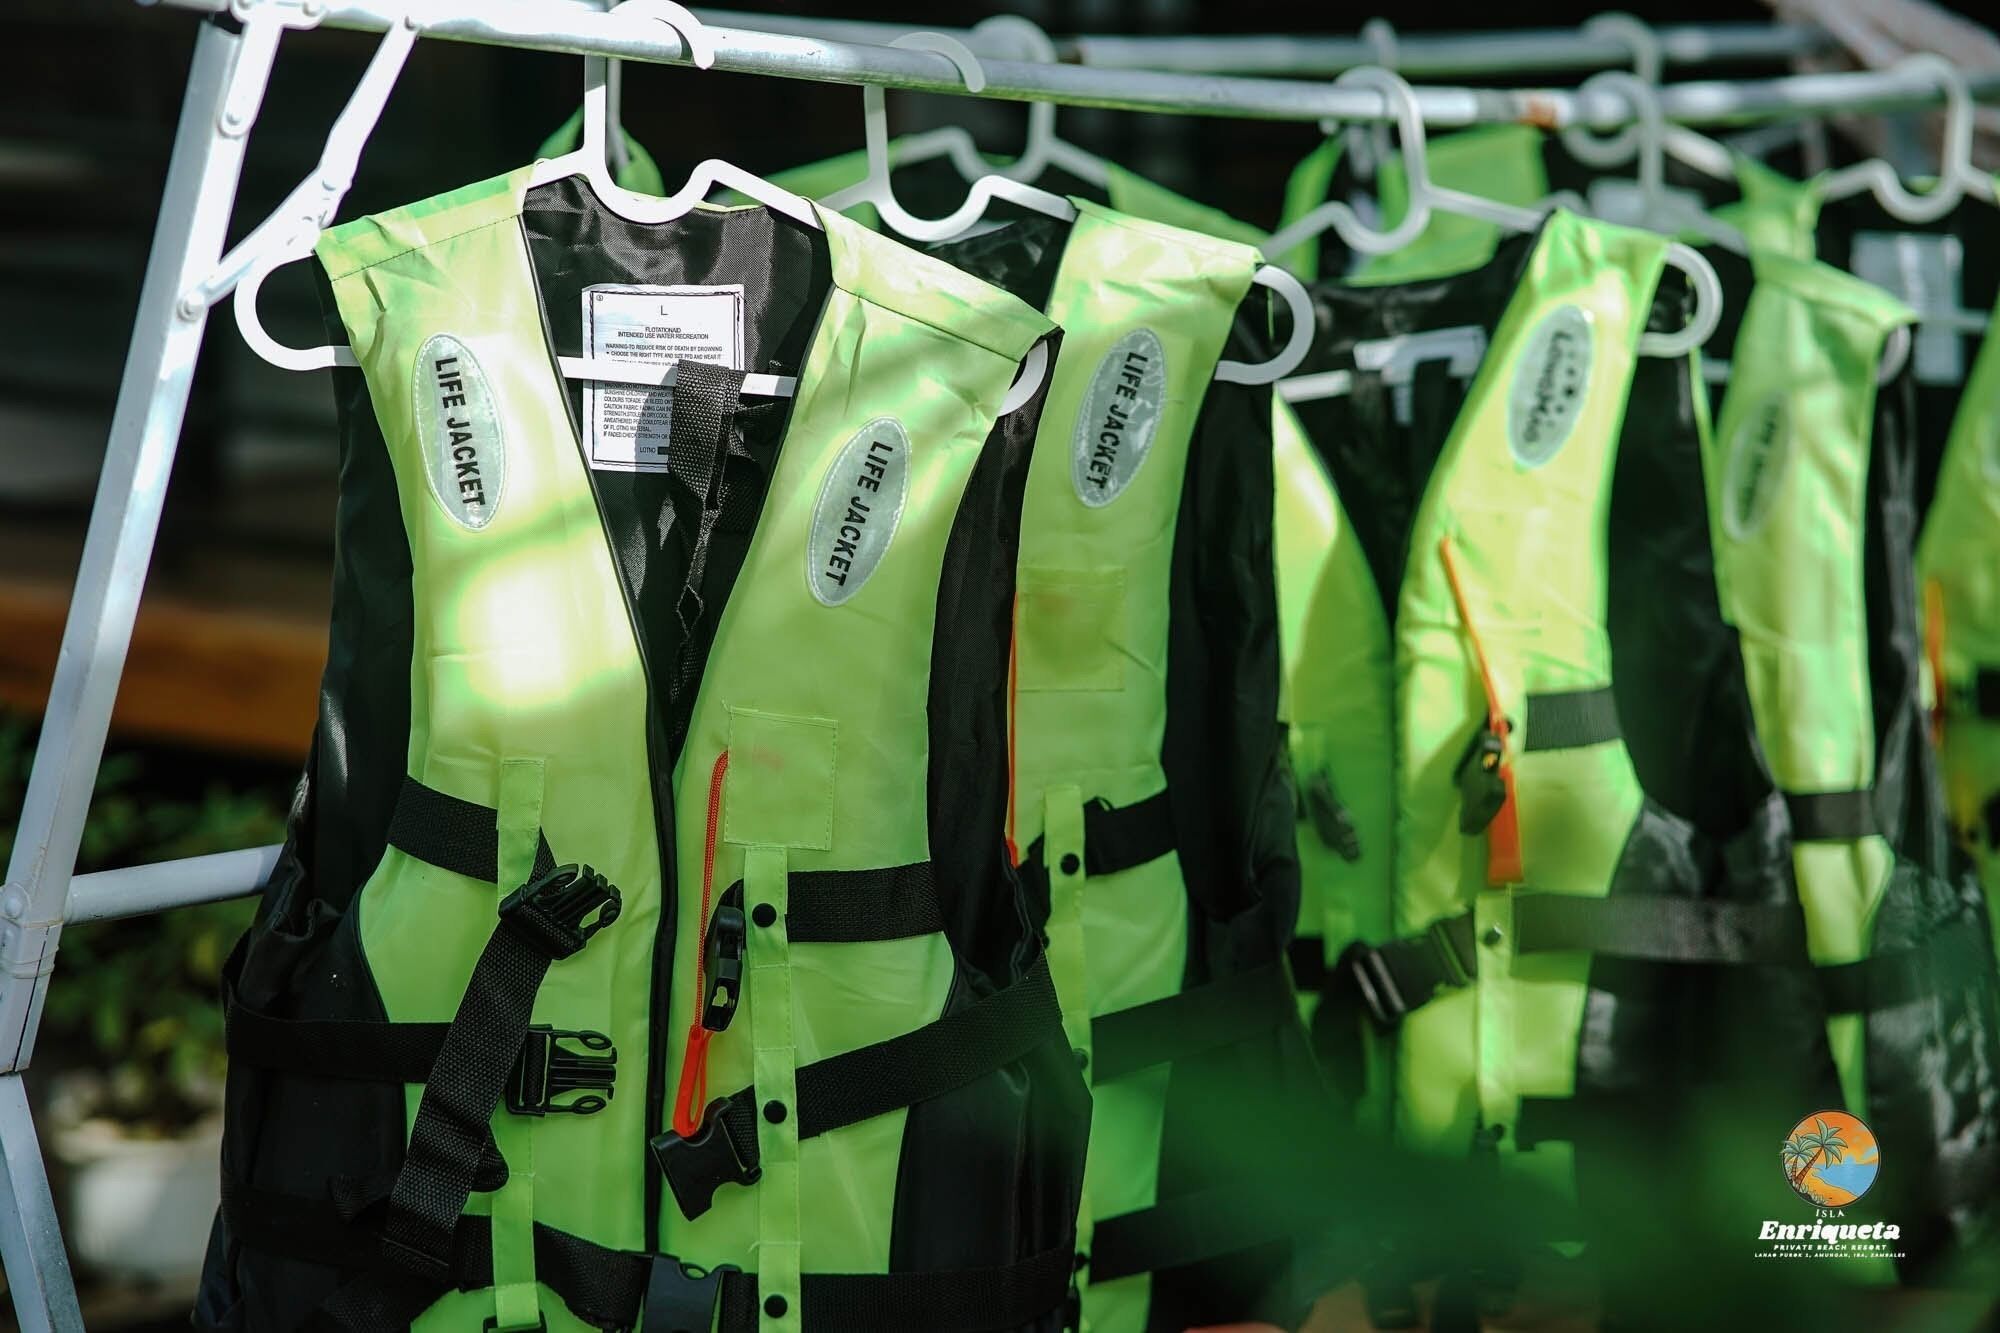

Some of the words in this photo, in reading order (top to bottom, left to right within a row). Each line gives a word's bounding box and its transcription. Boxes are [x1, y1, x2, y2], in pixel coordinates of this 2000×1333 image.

[660, 305, 669, 316] L
[434, 357, 467, 409] LIFE
[1114, 351, 1149, 401] LIFE
[446, 416, 486, 506] JACKET
[857, 440, 894, 493] LIFE
[1085, 403, 1129, 490] JACKET
[825, 495, 871, 587] JACKET
